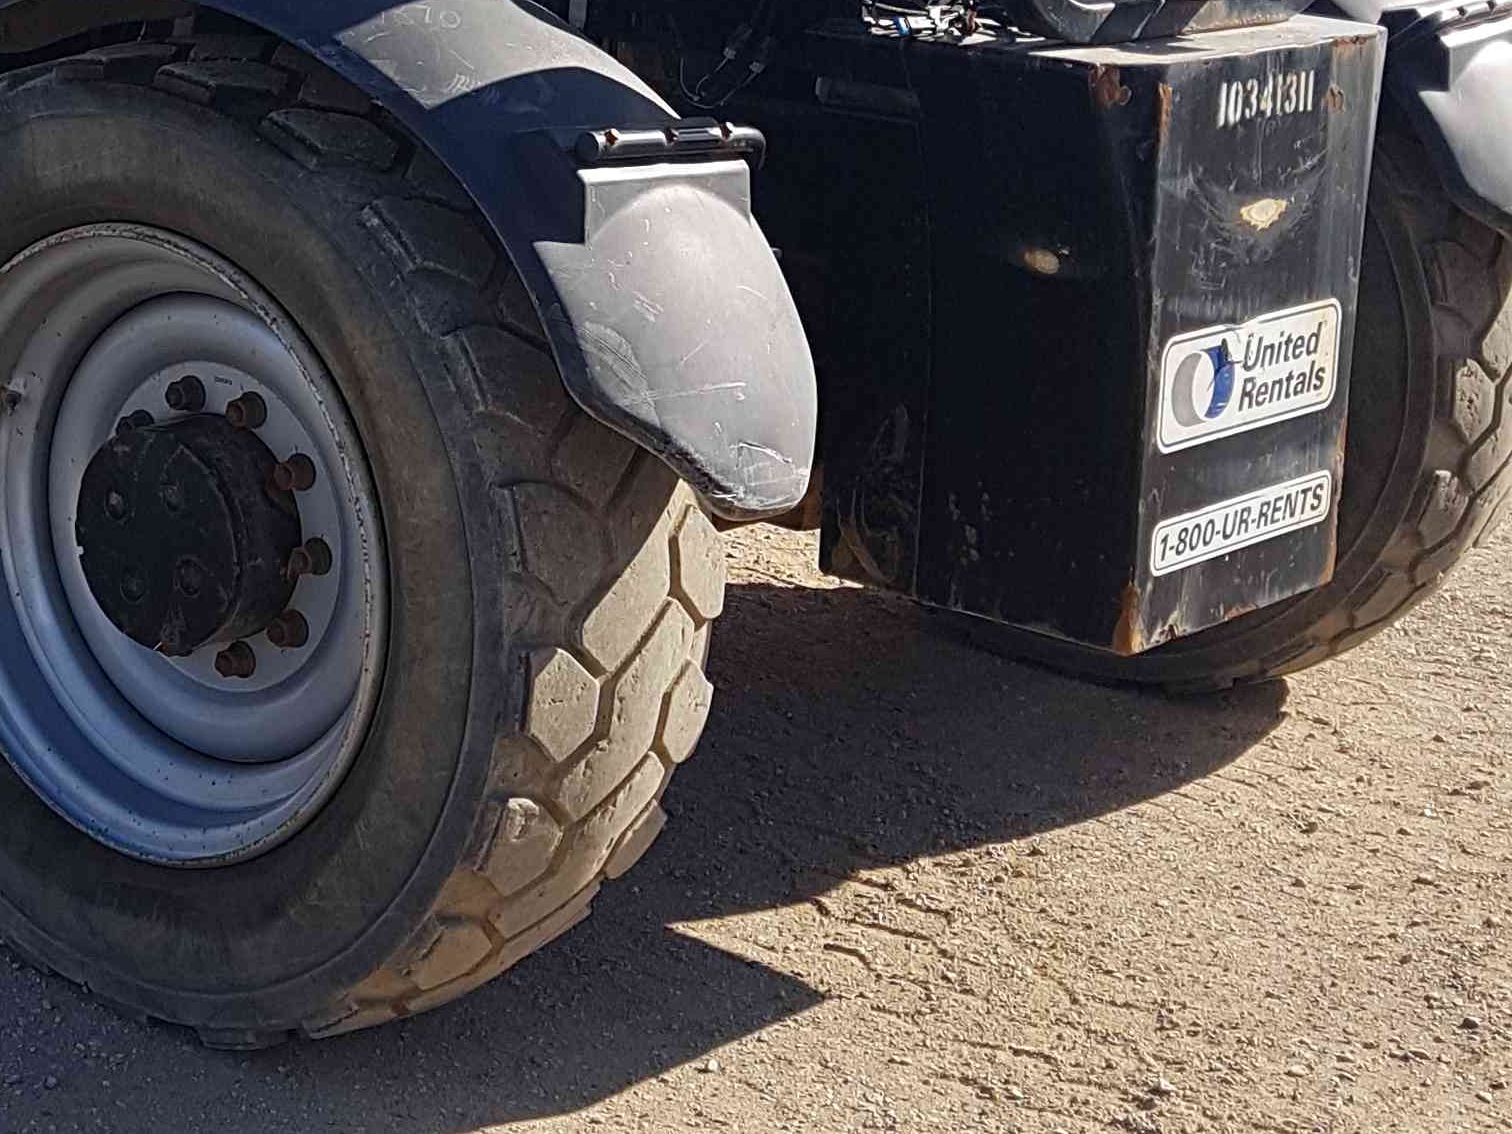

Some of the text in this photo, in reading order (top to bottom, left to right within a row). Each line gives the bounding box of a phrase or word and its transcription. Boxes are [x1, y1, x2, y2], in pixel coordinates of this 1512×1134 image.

[1217, 69, 1315, 128] 10341311
[1242, 321, 1323, 373] United
[1238, 360, 1326, 412] Rentals
[1159, 483, 1325, 562] 1-800-UR-RENTS
